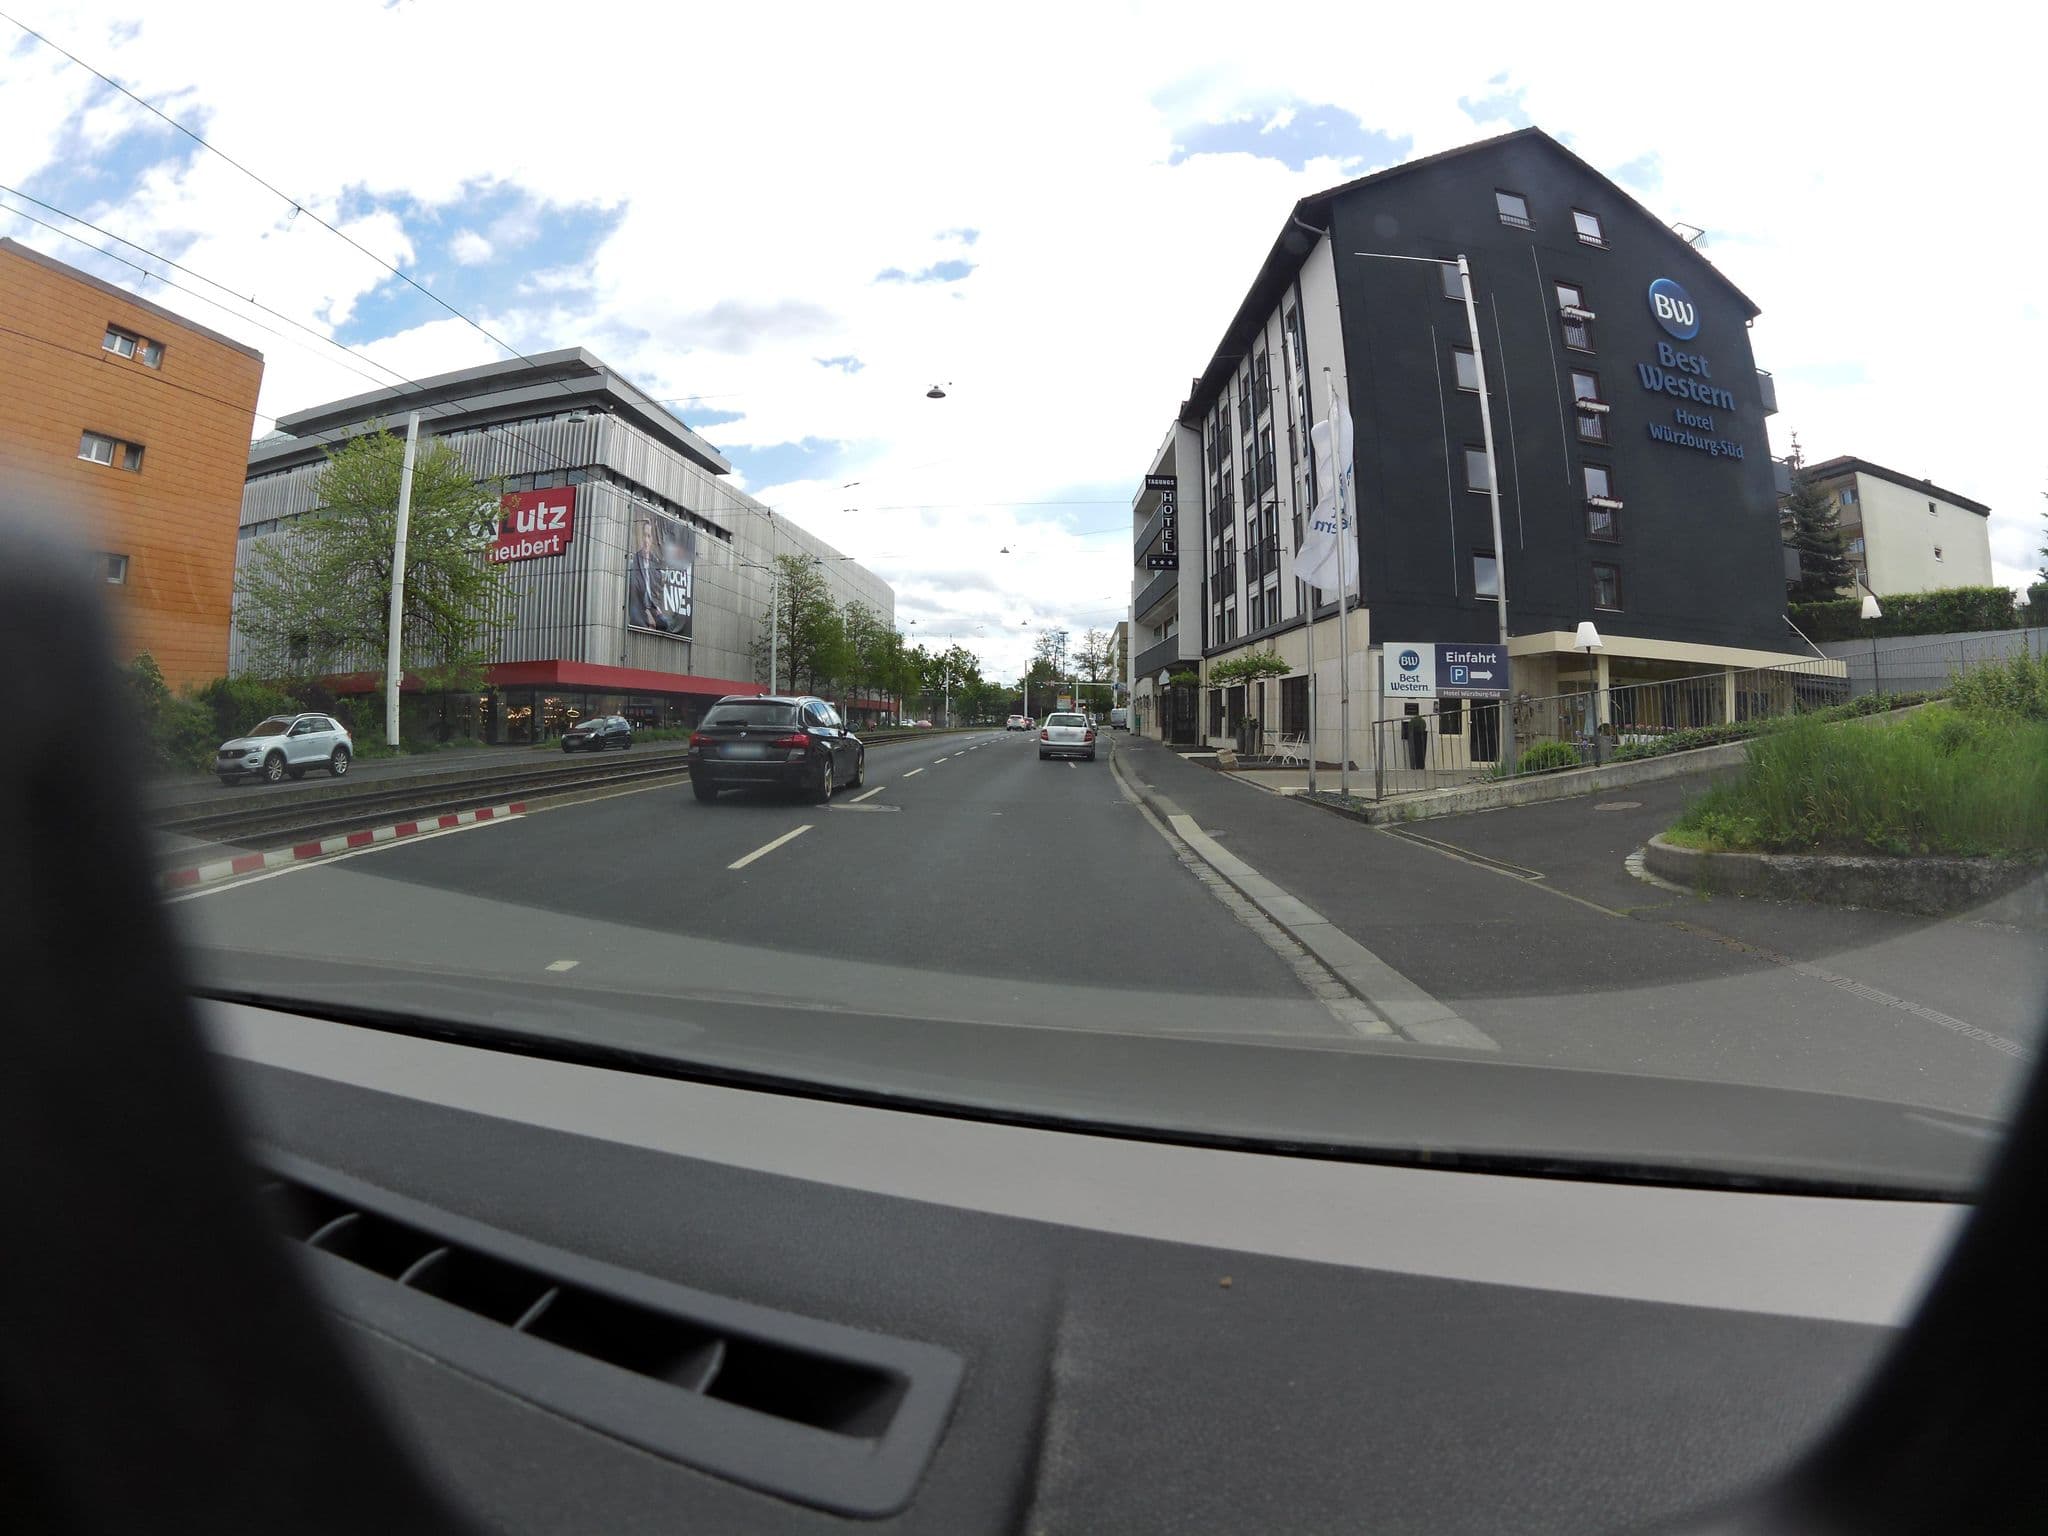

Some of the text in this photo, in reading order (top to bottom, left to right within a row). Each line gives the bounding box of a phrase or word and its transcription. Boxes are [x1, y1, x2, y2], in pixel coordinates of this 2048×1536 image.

[1654, 293, 1694, 326] BW
[1657, 341, 1712, 379] Best
[1637, 362, 1736, 411] Western
[1675, 407, 1714, 432] Hotel
[1650, 423, 1744, 459] Würzburg-Süd
[1147, 478, 1175, 486] TAGUNGS
[1163, 491, 1173, 553] HOTEL
[663, 572, 693, 617] NIE!
[1400, 656, 1418, 667] BW
[1445, 651, 1497, 664] Einfahrt
[1390, 682, 1428, 691] Western
[1399, 673, 1420, 682] Best
[1455, 668, 1464, 681] P
